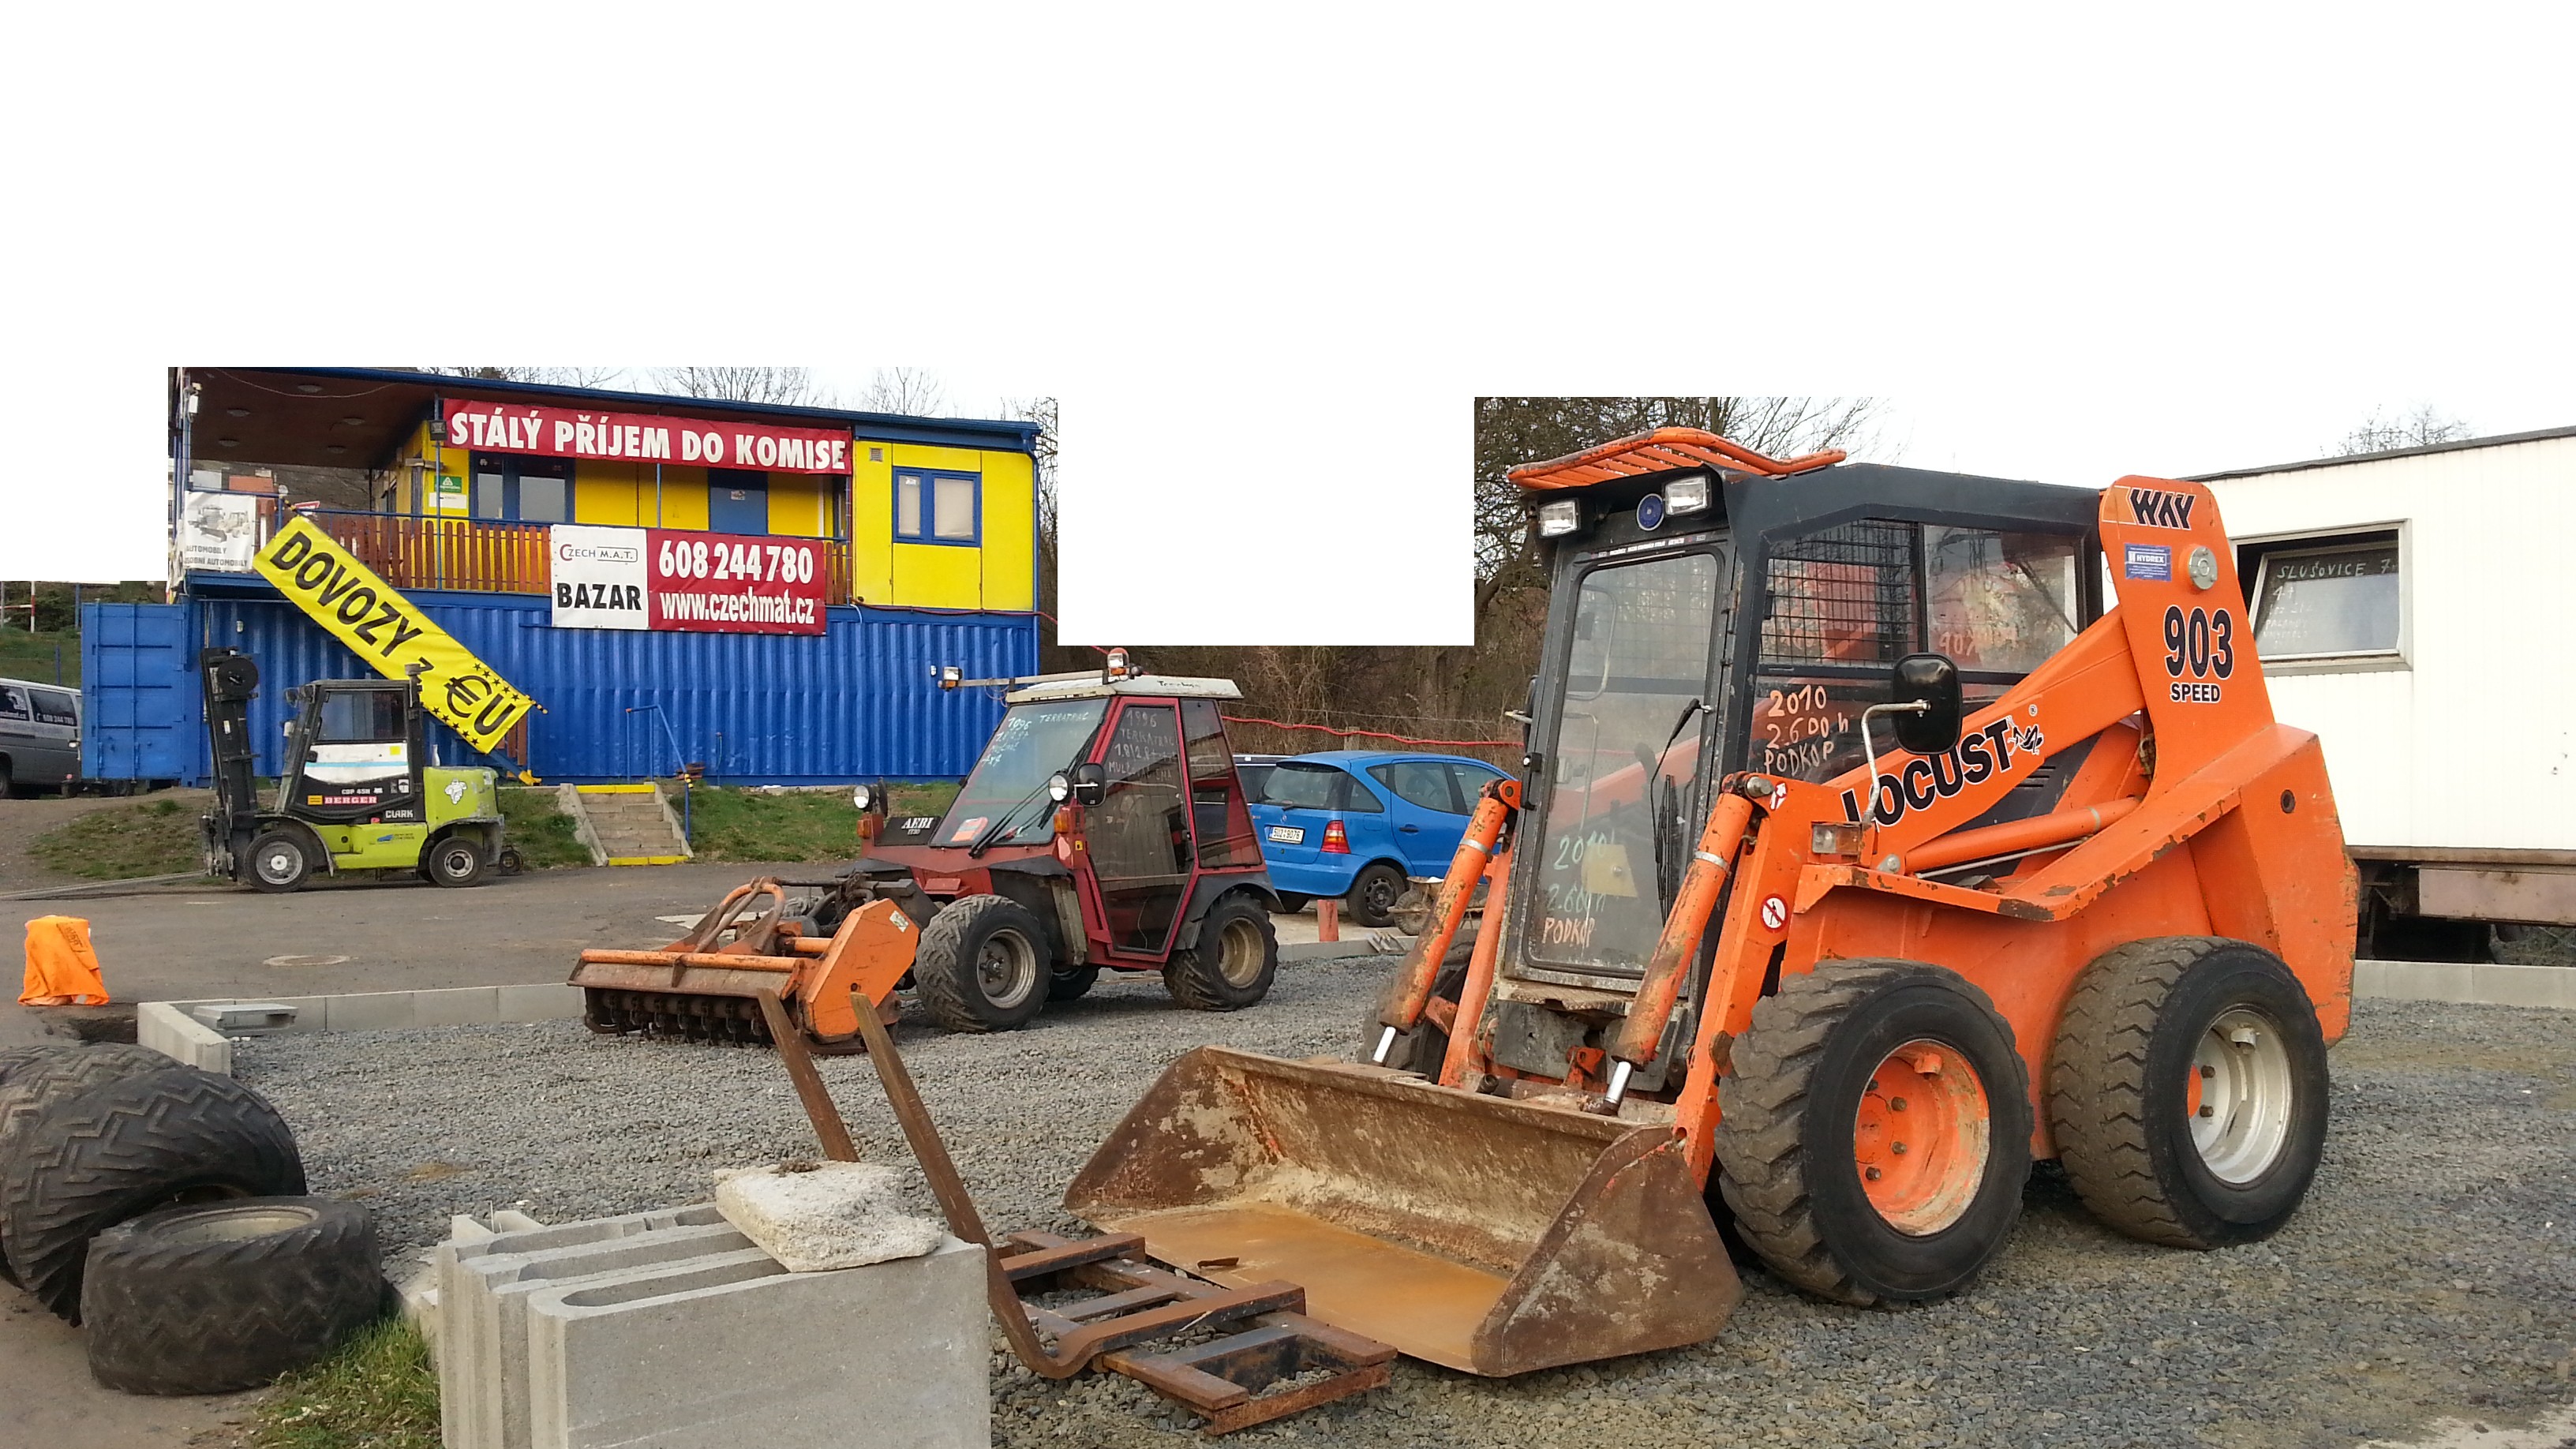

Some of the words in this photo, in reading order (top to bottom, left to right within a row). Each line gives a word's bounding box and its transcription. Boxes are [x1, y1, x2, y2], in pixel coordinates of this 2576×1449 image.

[451, 406, 543, 450] STÁLÝ
[554, 414, 671, 460] PŘÍJEM
[681, 429, 724, 464] DO
[735, 434, 845, 470] KOMISE
[2130, 488, 2197, 531] WAY
[560, 544, 596, 561] CZECH
[658, 540, 709, 579] 608
[713, 542, 762, 581] 244
[766, 545, 814, 584] 780
[2277, 560, 2367, 579] SLUŠOVICE
[269, 530, 424, 658] DOVOZY
[556, 582, 642, 611] BAZAR
[659, 586, 815, 624] www.czechmat.cz
[2164, 605, 2233, 680] 903
[1768, 684, 1827, 717] 2010
[2170, 682, 2222, 703] SPEED
[1126, 710, 1158, 728] 1996
[1837, 712, 1848, 733] h
[1764, 740, 1834, 777] PODKOP
[1840, 718, 2012, 827] LOCUST
[385, 810, 414, 818] CLARK
[900, 817, 934, 829] AEBI
[1553, 830, 1608, 871] 2010
[1541, 916, 1597, 949] PODKOP
